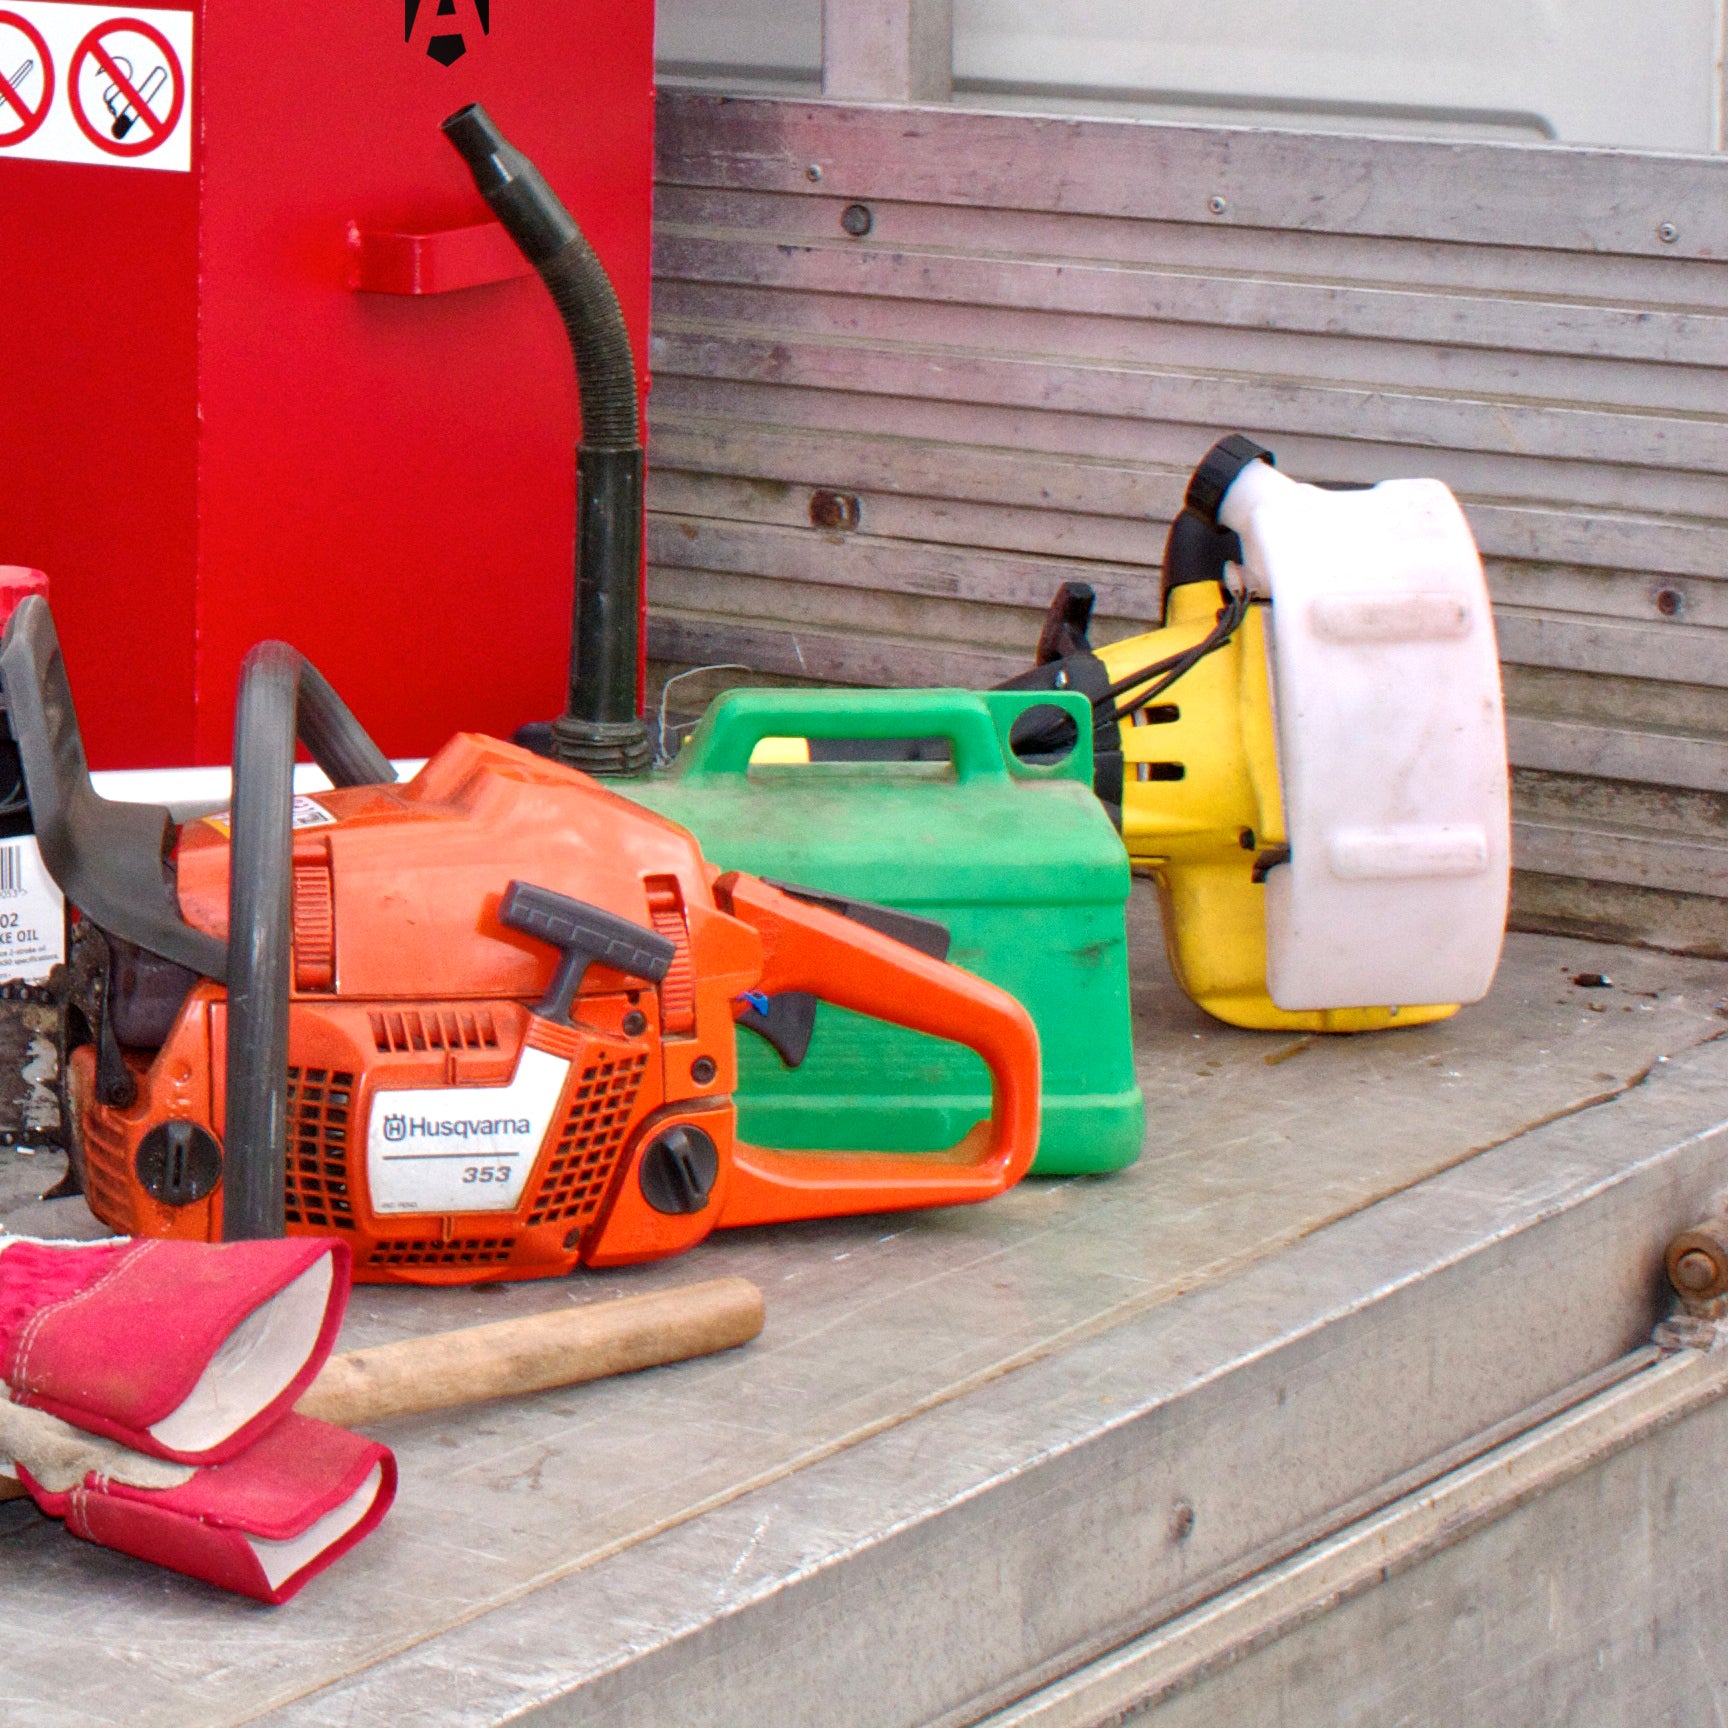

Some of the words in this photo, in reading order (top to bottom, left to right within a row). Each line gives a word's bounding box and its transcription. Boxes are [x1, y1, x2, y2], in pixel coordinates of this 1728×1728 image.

[16, 929, 39, 943] OIL
[409, 1116, 531, 1139] Husqvarna
[461, 1166, 512, 1184] 353
